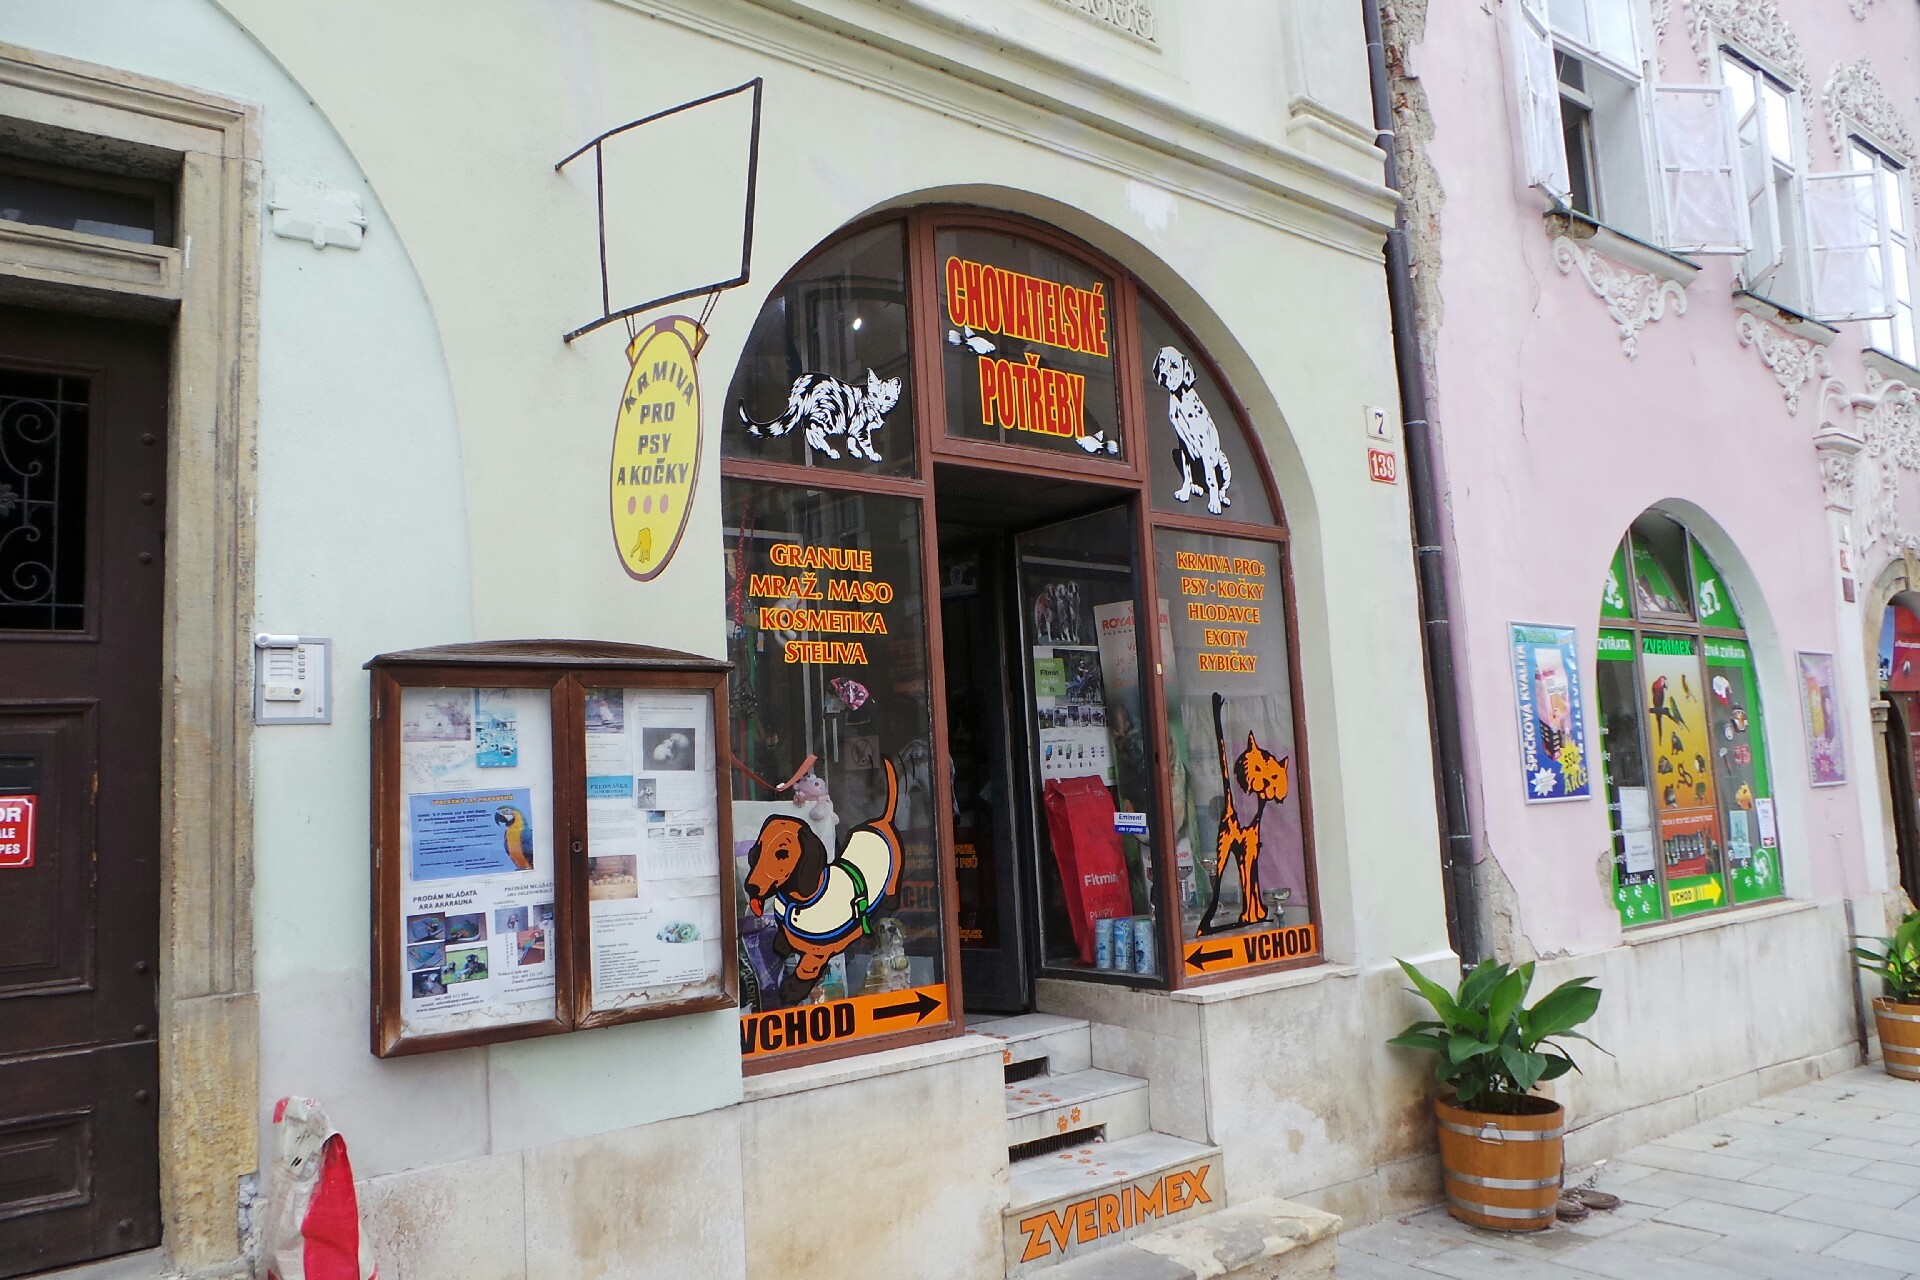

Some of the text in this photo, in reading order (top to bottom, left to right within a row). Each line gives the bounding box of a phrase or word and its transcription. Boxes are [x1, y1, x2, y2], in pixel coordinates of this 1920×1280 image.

[945, 255, 1109, 358] CHOVATELSKÉ
[624, 359, 695, 415] KRMIVA
[978, 351, 1086, 439] POTŘEBY
[639, 401, 676, 425] PRO
[1374, 411, 1384, 435] 7
[637, 432, 672, 455] PSY
[616, 457, 690, 486] A KOČKY
[1371, 453, 1395, 479] 139
[769, 543, 873, 572] GRANULE
[1176, 551, 1266, 578] KRMIVA PRO:
[749, 571, 893, 604] MRAŽ. MASO
[1181, 576, 1265, 600] PSY KOČKY
[759, 606, 888, 635] KOSMETIKA
[1187, 602, 1261, 625] HLODAVCE
[1204, 628, 1249, 648] EXOTY
[1597, 635, 1631, 651] ZVÍŘATA
[1642, 637, 1693, 656] ZVERIMEX
[784, 640, 869, 665] STELIVA
[1198, 650, 1258, 673] RYBIČKY
[1515, 644, 1538, 772] ŠPIČKOVÁ KVALITA
[1083, 871, 1118, 886] Fitmin
[412, 889, 478, 903] PRODÁM MLÁĎATA
[418, 898, 473, 910] ARA ARARAUNA
[1671, 890, 1693, 903] VCHOD
[1242, 927, 1312, 964] VCHOD
[740, 1001, 856, 1055] VCHOD
[1020, 1164, 1212, 1263] ZVERIMEX
